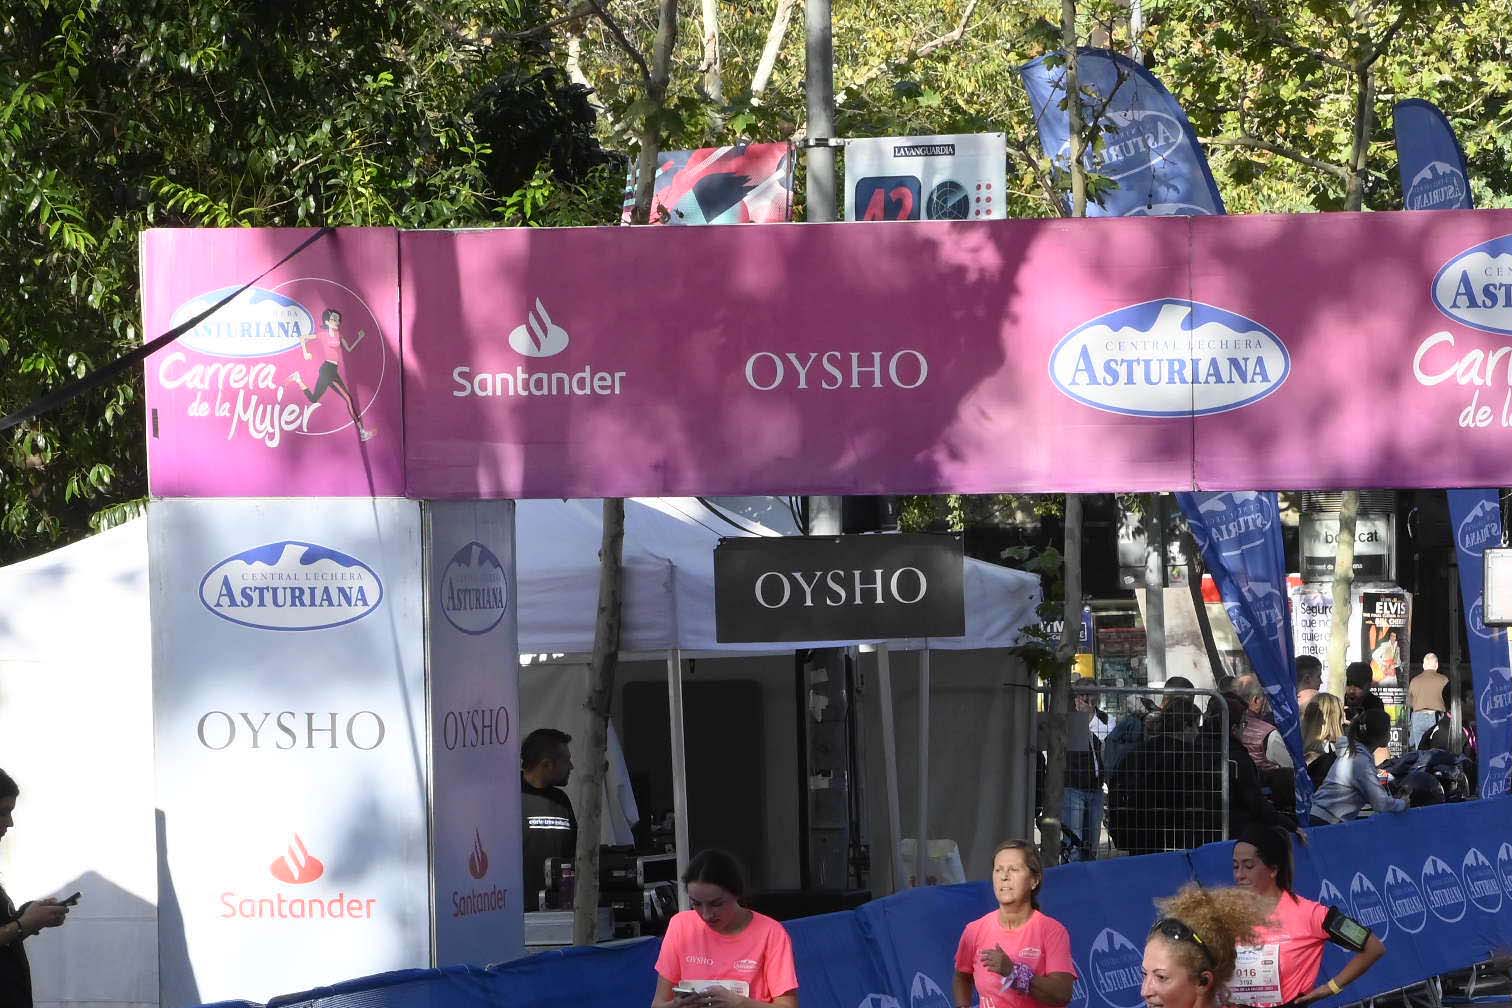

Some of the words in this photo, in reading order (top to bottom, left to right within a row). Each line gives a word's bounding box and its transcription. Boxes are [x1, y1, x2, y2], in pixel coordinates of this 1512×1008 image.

[158, 351, 277, 390] Carrera
[452, 365, 627, 398] Santander
[745, 349, 929, 391] OYSHO
[1069, 344, 1271, 386] ASTURIANA
[187, 392, 210, 418] de
[215, 391, 232, 418] la
[228, 387, 323, 449] Mujer
[1458, 391, 1494, 429] de
[213, 574, 370, 609] ASTURIANA
[241, 572, 300, 581] CENTRAL
[304, 572, 364, 581] LECHERA
[446, 575, 503, 613] ASTURIANA
[755, 566, 928, 609] OYSHO
[1375, 602, 1406, 614] ELVIS
[198, 711, 387, 751] OYSHO
[443, 706, 511, 752] OYSHO
[221, 892, 376, 919] Santander
[452, 883, 509, 918] Santander
